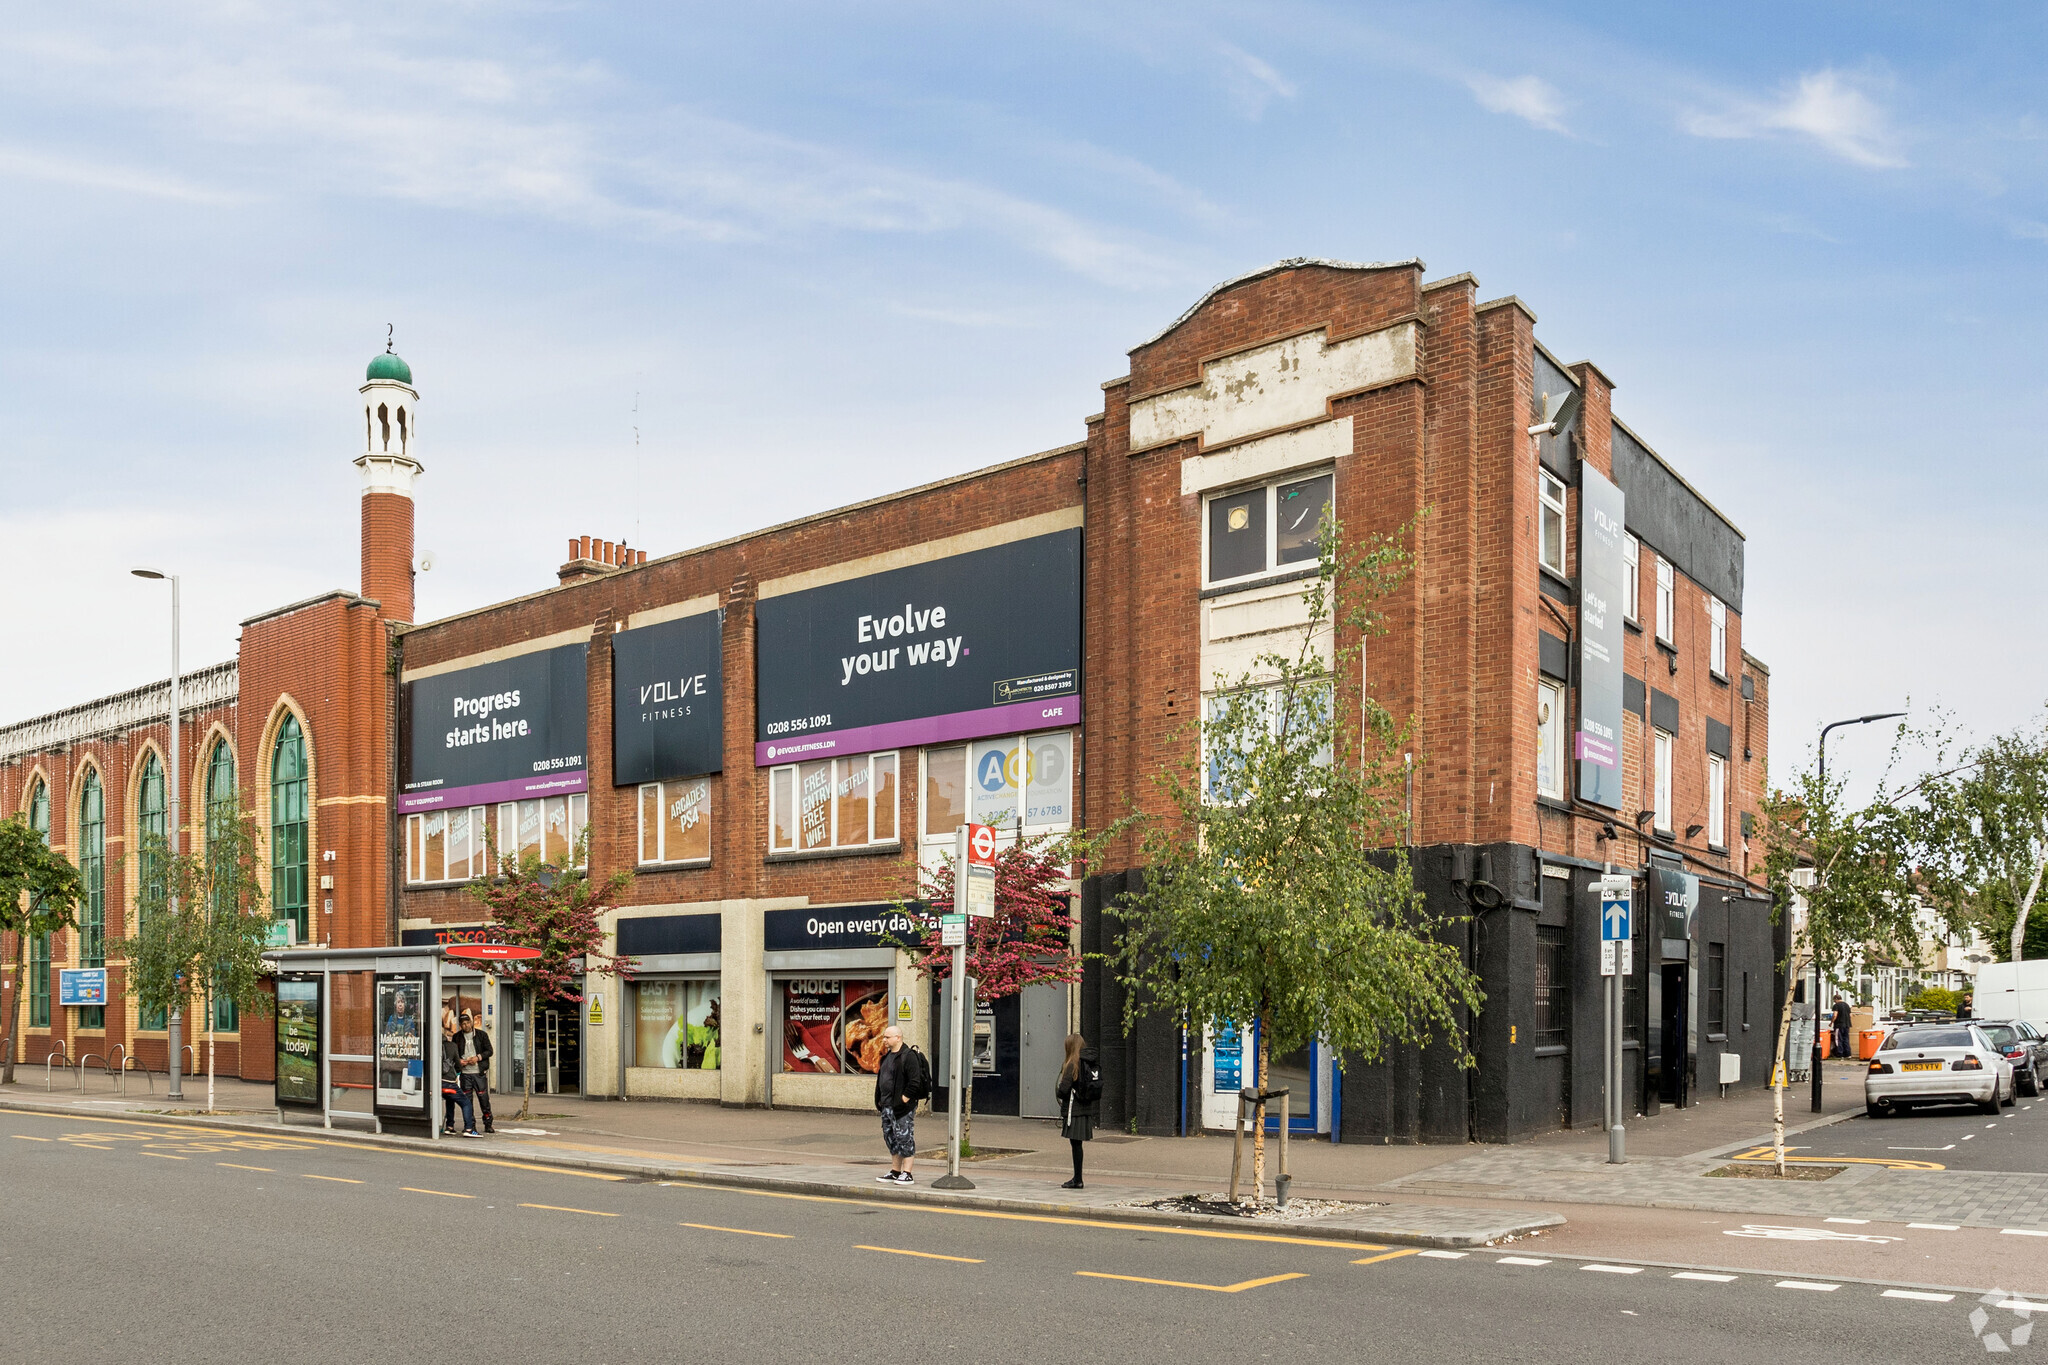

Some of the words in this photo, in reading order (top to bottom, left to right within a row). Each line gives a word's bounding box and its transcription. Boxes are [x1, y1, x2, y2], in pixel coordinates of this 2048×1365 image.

[858, 603, 947, 643] Evolve
[1584, 610, 1603, 631] started
[842, 648, 900, 685] your
[906, 635, 970, 667] way.
[1045, 683, 1058, 691] 8507
[1059, 681, 1072, 689] 3395
[454, 690, 520, 719] Progress
[642, 706, 692, 722] FITNESS
[1042, 708, 1063, 718] CAFE
[446, 724, 490, 748] starts
[492, 718, 531, 741] here.
[767, 722, 789, 735] 0208
[791, 718, 808, 731] 556
[810, 714, 832, 728] 1091
[534, 760, 551, 771] 0208
[551, 758, 564, 769] 556
[565, 755, 582, 767] 1091
[804, 767, 827, 795] FREE
[838, 767, 869, 796] NETFLIX
[671, 783, 706, 821] ARCADES
[802, 782, 832, 815] ENTRY
[550, 805, 566, 831] PS3
[680, 806, 700, 833] PS4
[802, 805, 826, 832] FREE
[1041, 806, 1063, 816] 6788
[426, 813, 444, 841] POOL
[806, 823, 827, 849] WIFI
[1669, 910, 1685, 919] FITNESS
[807, 918, 844, 938] Open
[847, 918, 887, 936] every
[889, 914, 914, 935] day
[790, 980, 840, 994] CHOICE
[289, 1025, 298, 1036] be
[381, 1034, 404, 1047] Making
[404, 1034, 420, 1047] your
[286, 1039, 310, 1057] today
[381, 1045, 399, 1055] effort
[1924, 1062, 1939, 1070] VTV
